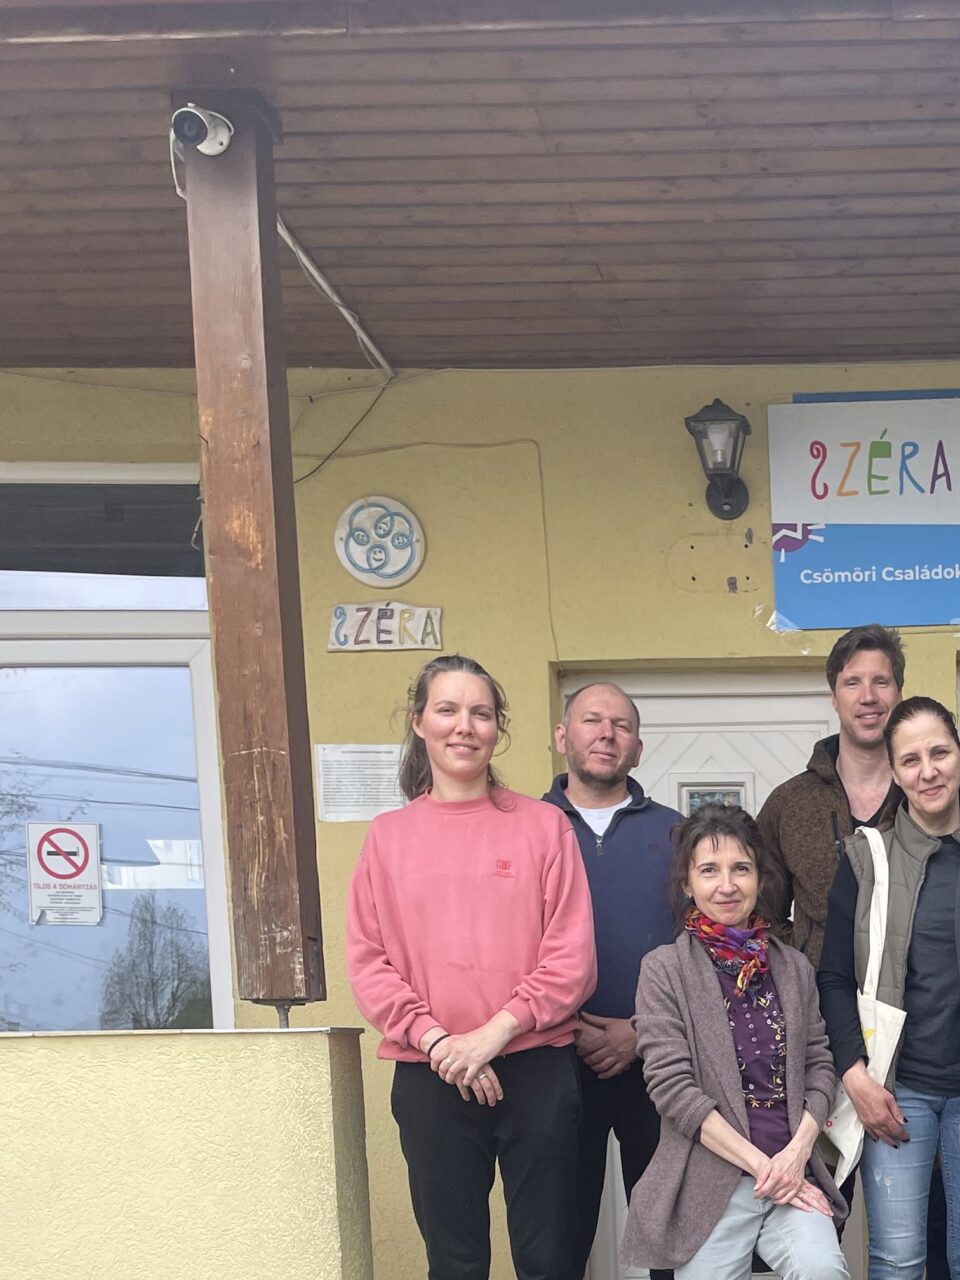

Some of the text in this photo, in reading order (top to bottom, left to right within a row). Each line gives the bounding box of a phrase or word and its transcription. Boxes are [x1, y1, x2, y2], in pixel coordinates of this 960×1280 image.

[809, 427, 953, 501] SZÉRA
[800, 565, 877, 584] Csömöri
[333, 601, 440, 646] SZÉRA
